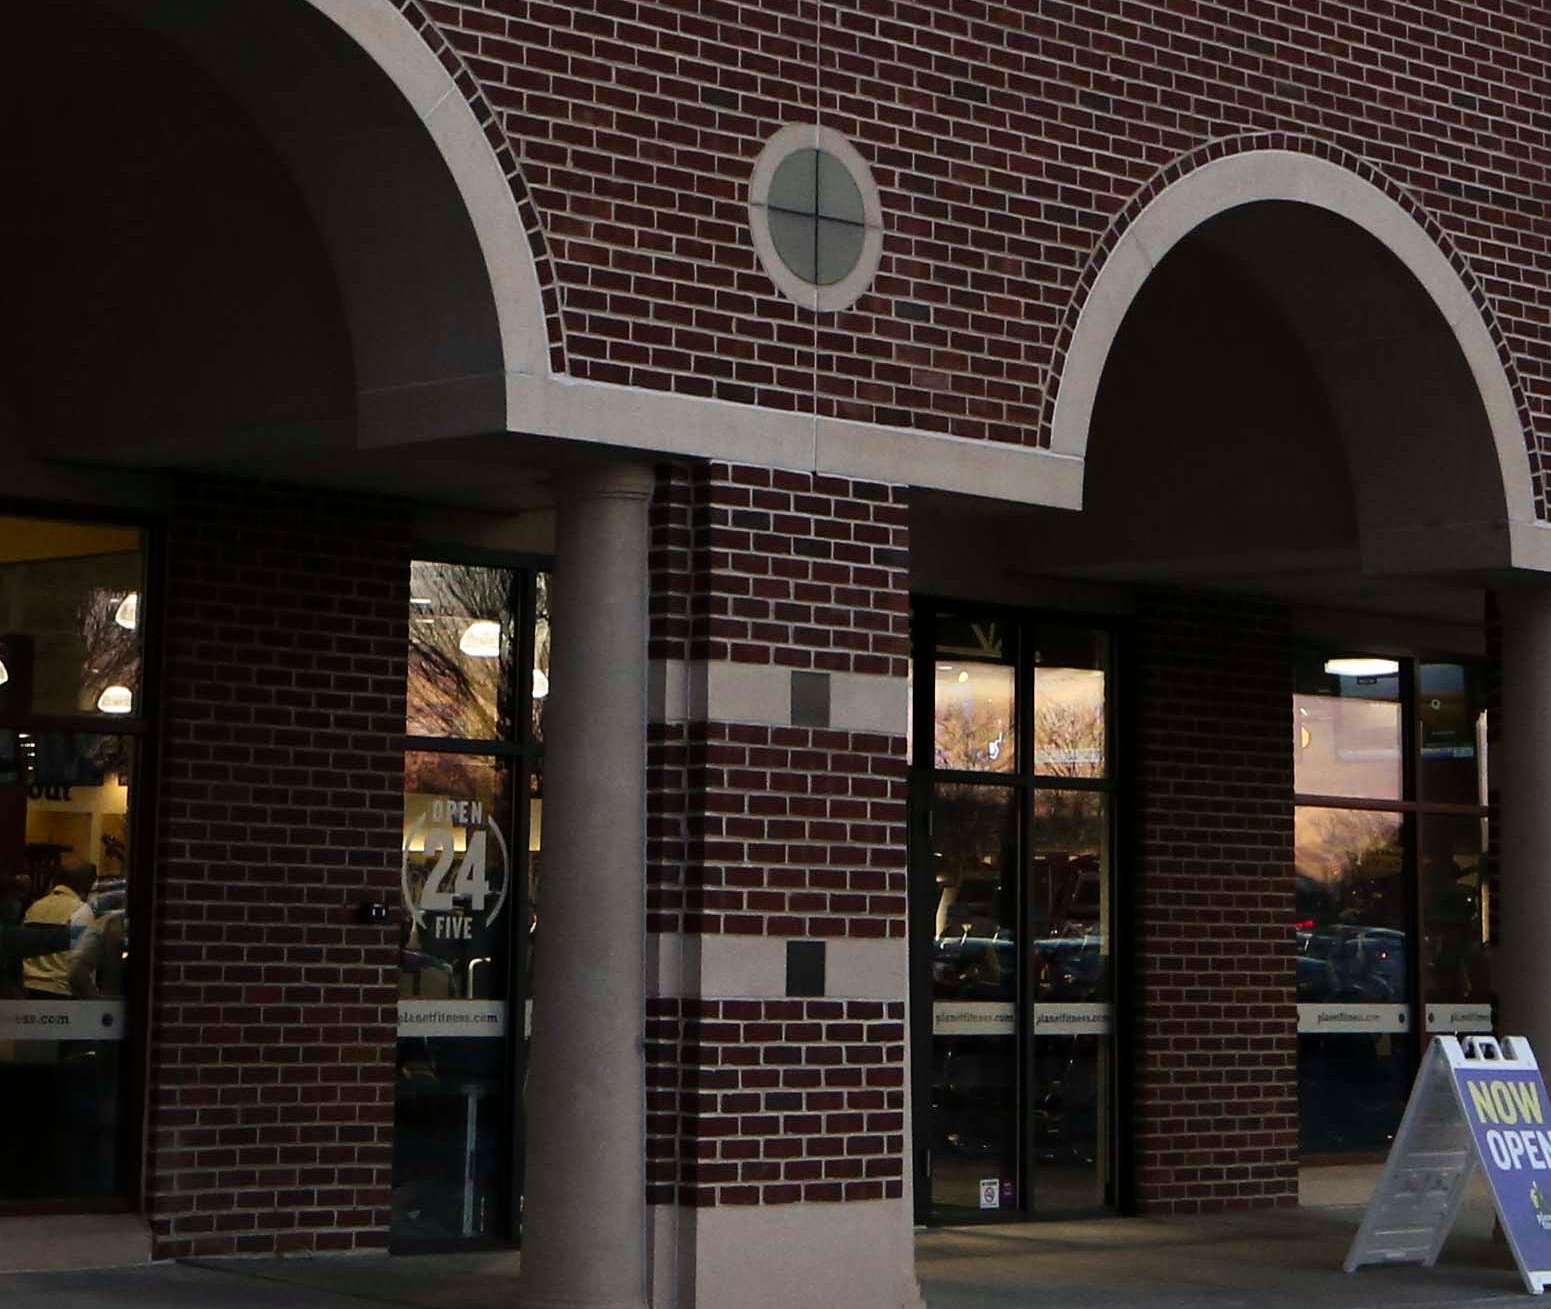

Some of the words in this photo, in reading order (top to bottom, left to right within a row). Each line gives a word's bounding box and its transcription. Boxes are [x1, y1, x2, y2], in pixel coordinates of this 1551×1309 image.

[432, 800, 483, 825] OPEN
[420, 829, 490, 910] 24
[435, 916, 473, 940] FIVE
[1467, 1081, 1544, 1124] NOW
